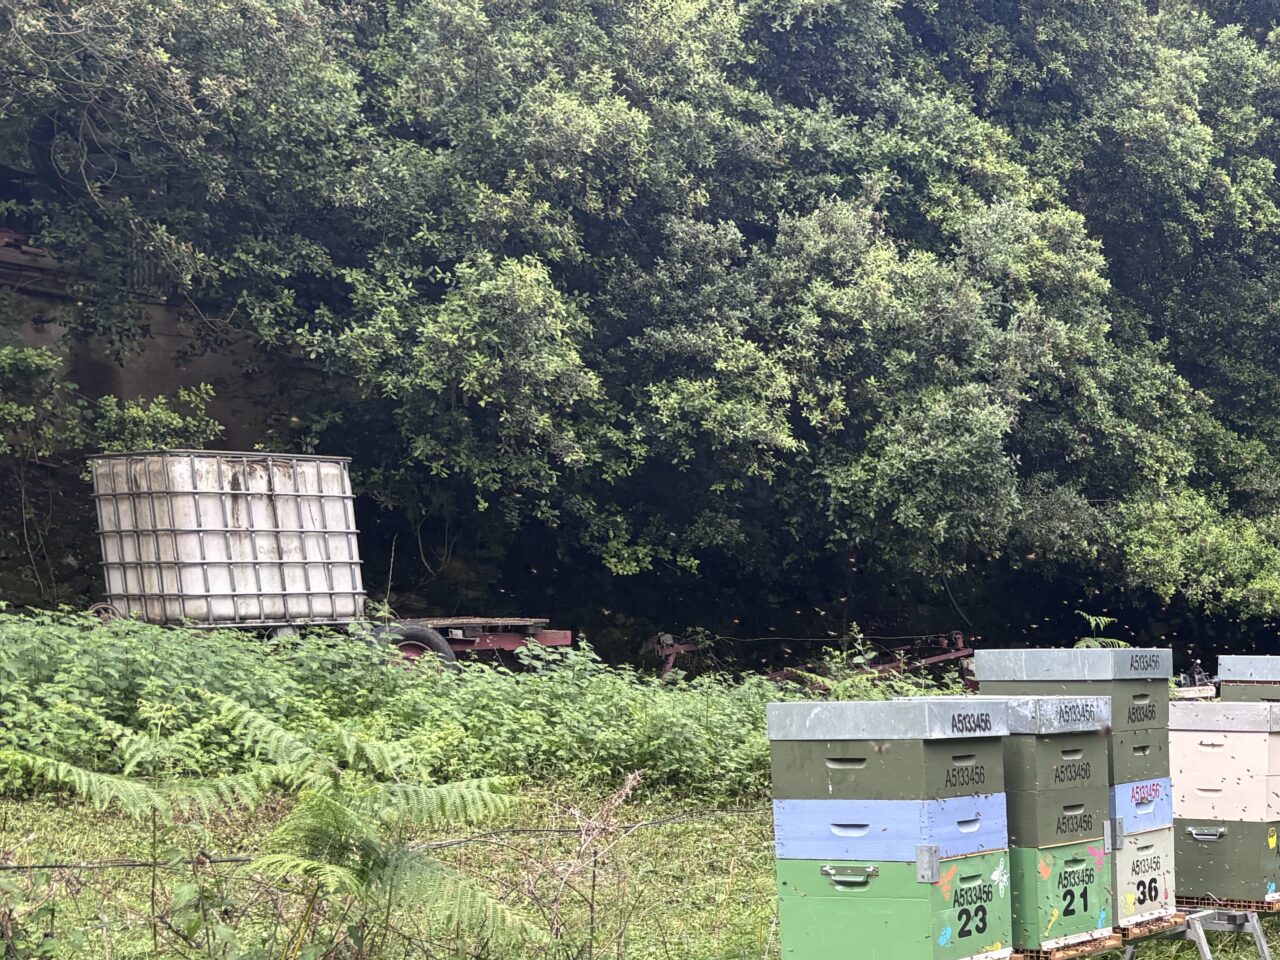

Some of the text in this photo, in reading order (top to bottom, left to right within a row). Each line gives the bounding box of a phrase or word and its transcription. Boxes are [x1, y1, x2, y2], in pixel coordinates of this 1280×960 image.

[1130, 654, 1160, 672] A5133456
[952, 713, 992, 733] A5133456
[1059, 703, 1095, 724] A5133456
[1128, 703, 1156, 724] A5133456
[945, 765, 985, 789] A5133456
[1054, 762, 1091, 784] A5133456
[1131, 782, 1160, 803] A5133456
[1056, 814, 1093, 834] A5133456
[1131, 856, 1161, 877] A5133456
[1057, 867, 1095, 890] A5133456
[953, 884, 993, 908] A5133456
[1062, 885, 1088, 917] 21
[1136, 877, 1159, 905] 36
[957, 904, 988, 938] 23
